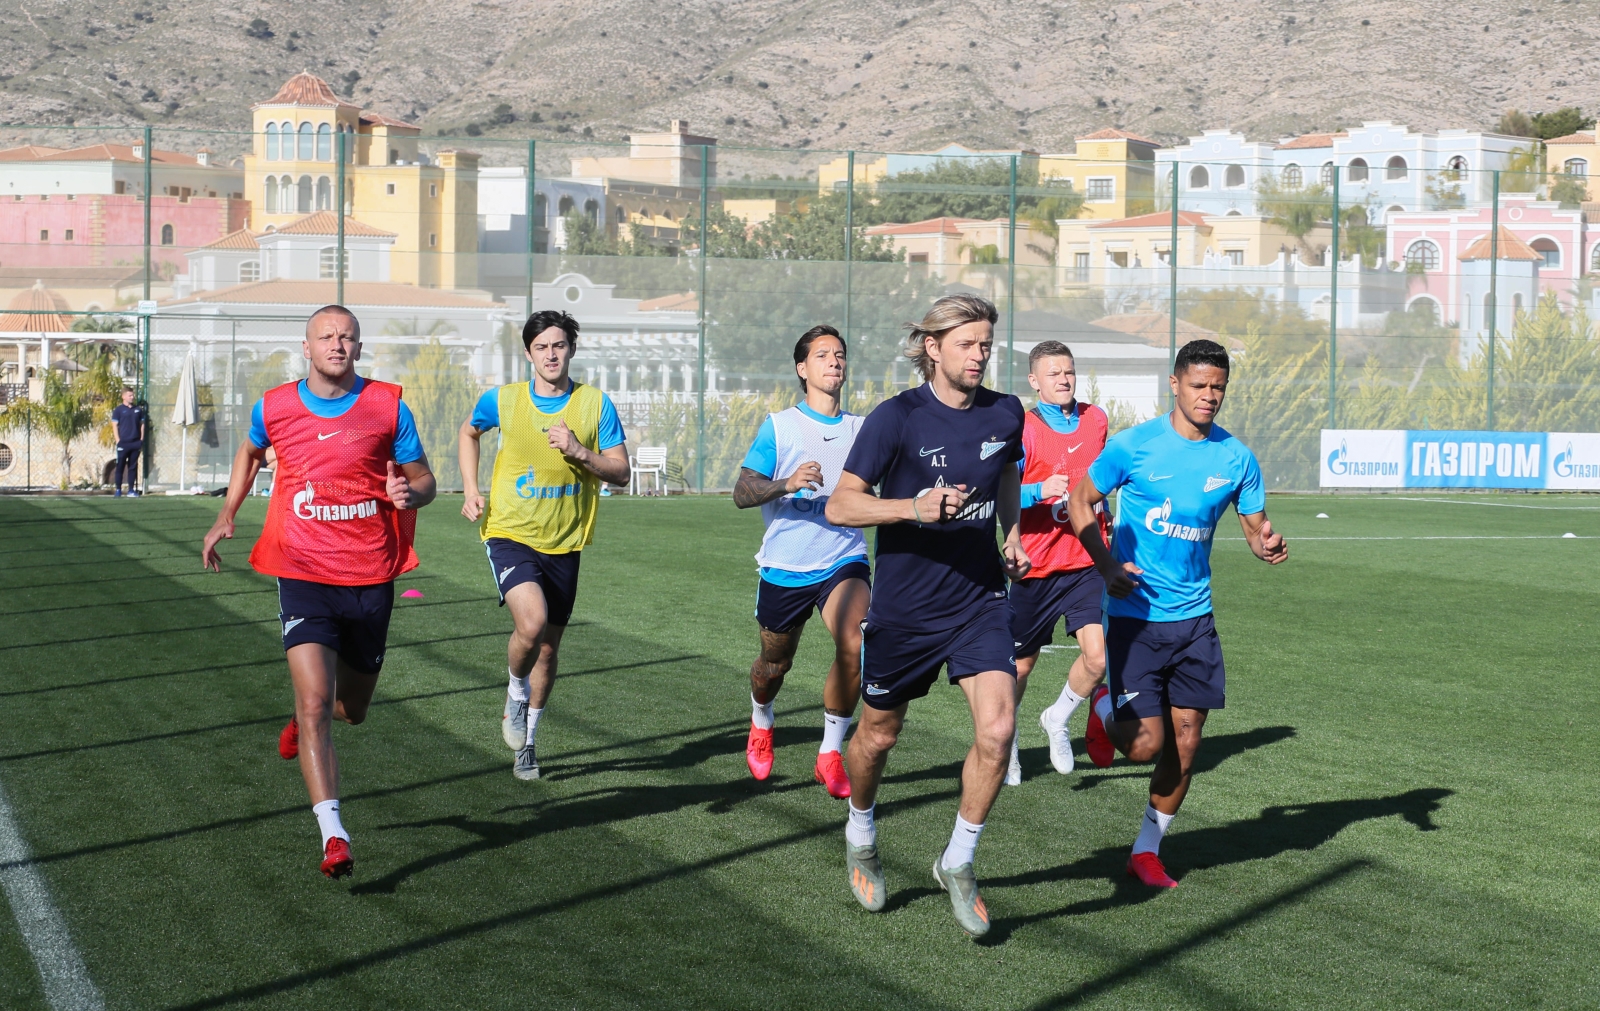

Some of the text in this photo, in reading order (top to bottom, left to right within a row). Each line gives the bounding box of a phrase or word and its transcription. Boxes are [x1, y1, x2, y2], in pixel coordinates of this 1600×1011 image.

[1411, 442, 1540, 478] ГАЗПРОМ
[1348, 462, 1399, 476] ГАЗПРОМ
[1573, 464, 1600, 478] ГАЗП
[535, 482, 581, 499] ГАЗПРОМ
[315, 500, 377, 521] ГАЗПРОМ
